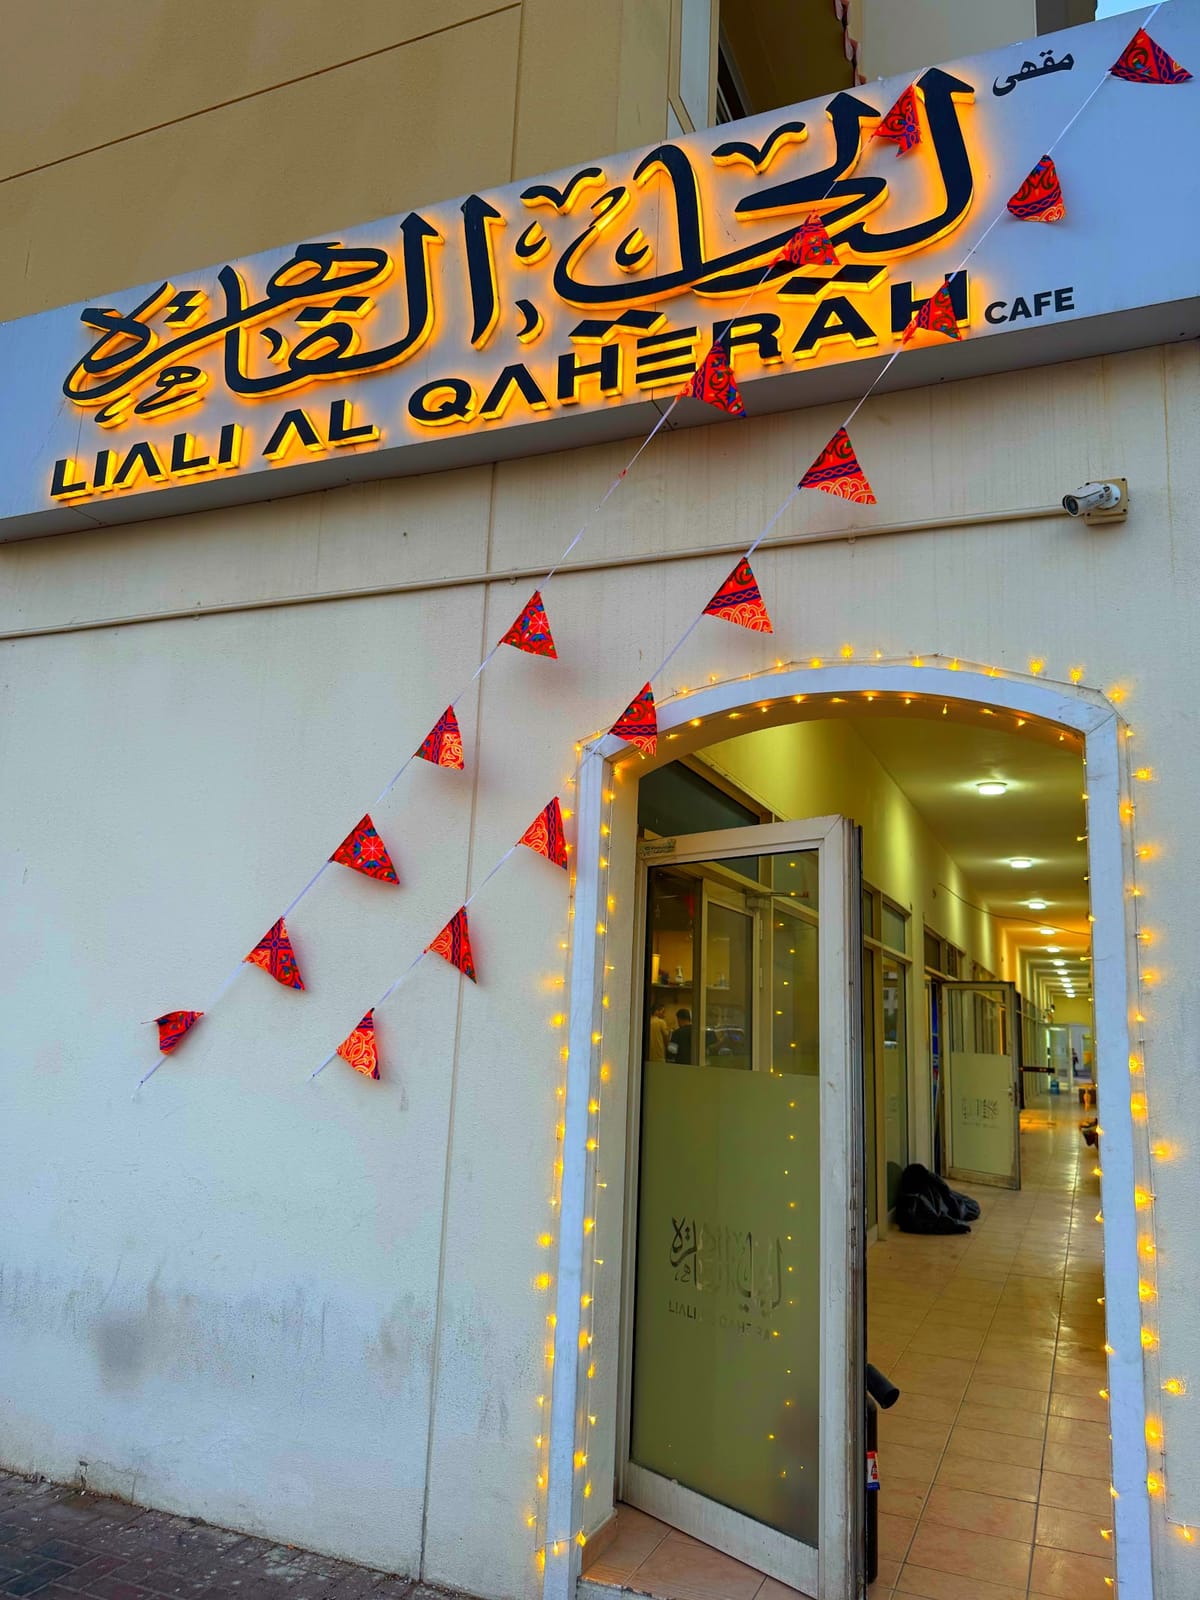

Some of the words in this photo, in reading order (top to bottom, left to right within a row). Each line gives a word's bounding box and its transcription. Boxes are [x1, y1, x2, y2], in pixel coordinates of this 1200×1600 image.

[992, 49, 1075, 97] مقهى
[50, 423, 243, 499] LIALI
[263, 400, 380, 461] AL
[408, 268, 970, 425] QAHERAH
[984, 286, 1075, 325] CAFE
[62, 194, 506, 429] القاهرة
